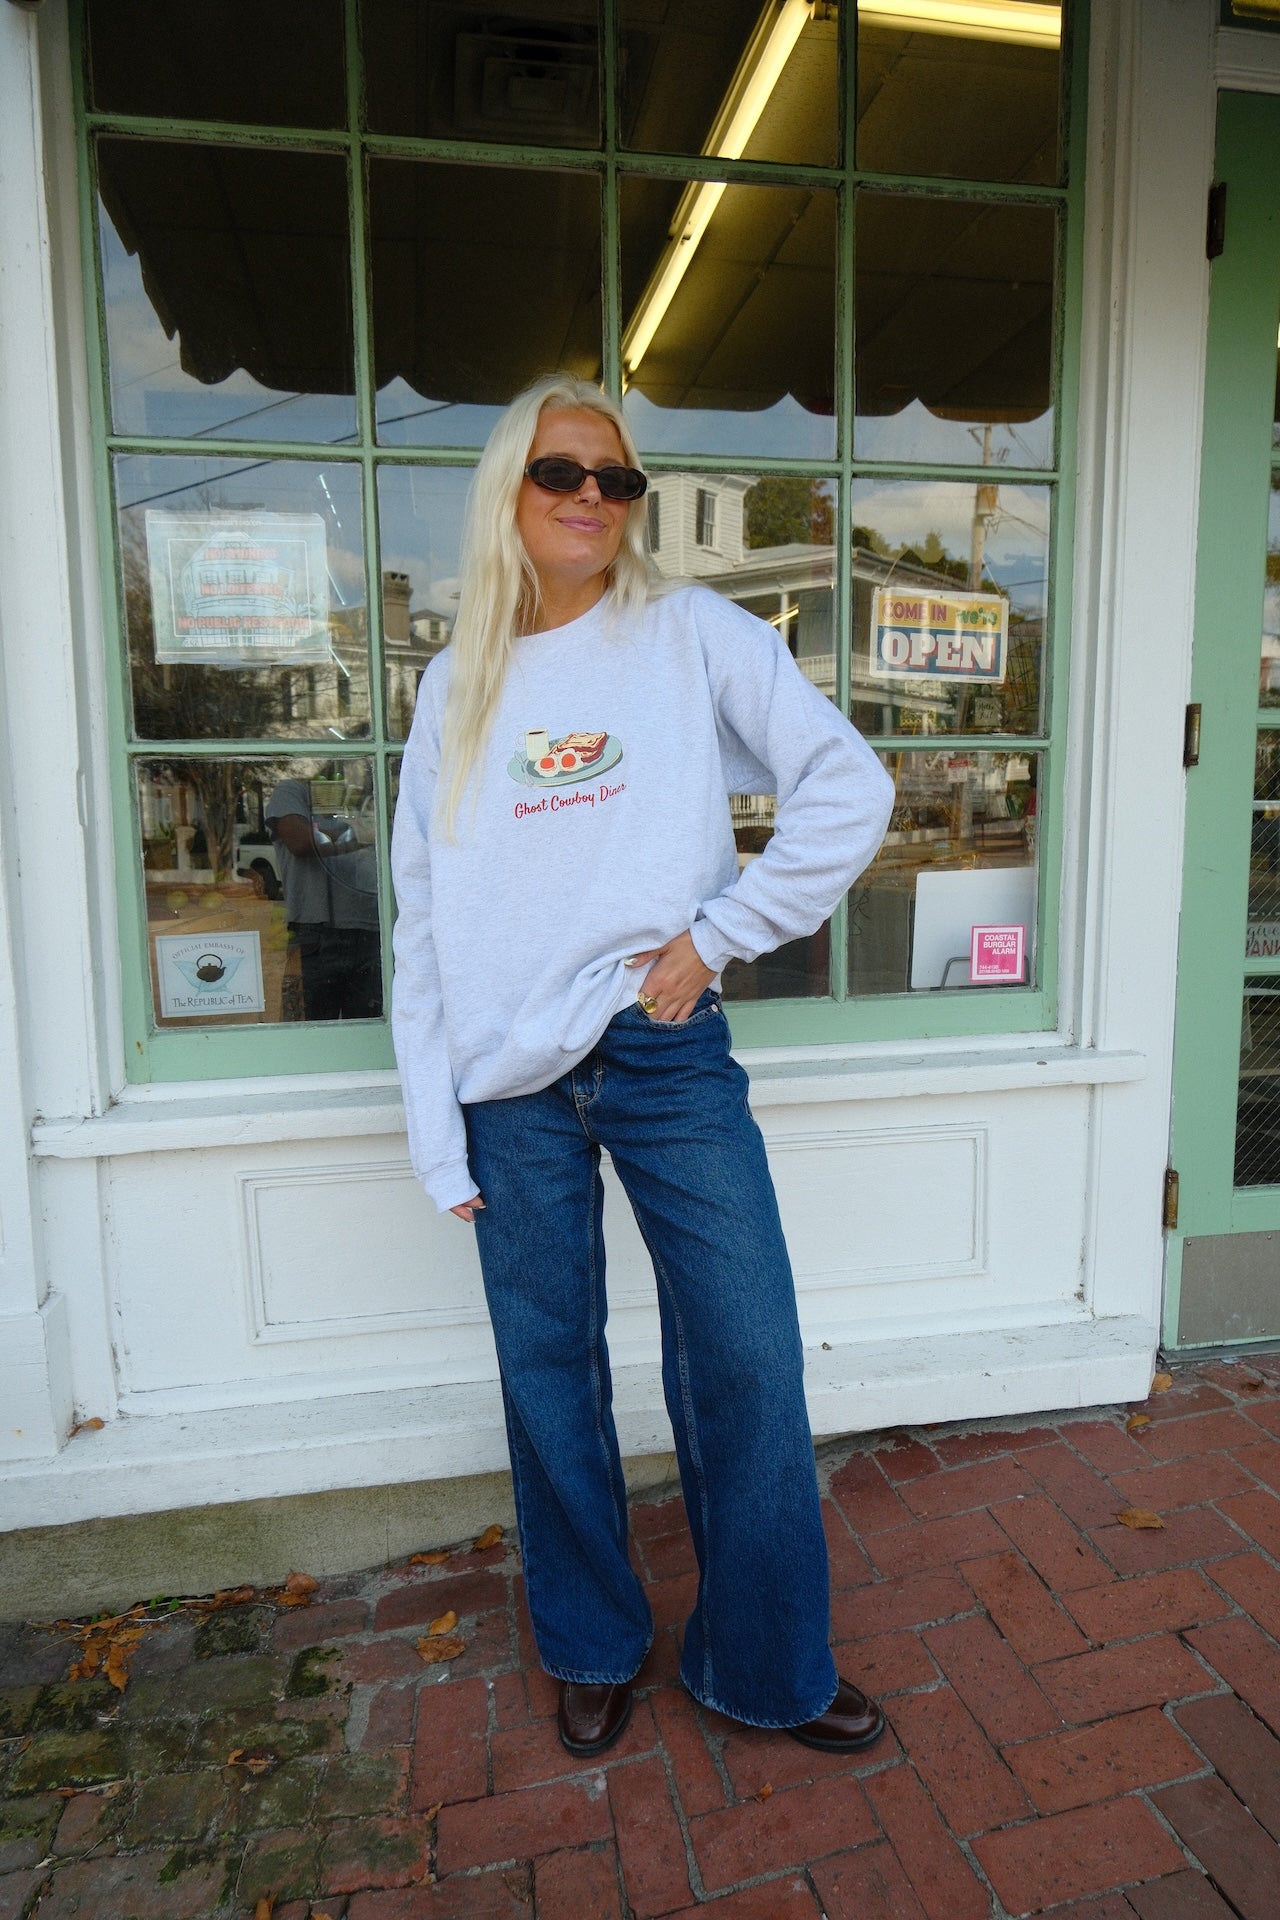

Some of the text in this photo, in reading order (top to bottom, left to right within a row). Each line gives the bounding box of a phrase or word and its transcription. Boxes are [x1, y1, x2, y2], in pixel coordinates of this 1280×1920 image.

[204, 547, 221, 560] NO
[201, 583, 217, 596] NO
[883, 601, 928, 620] COME
[931, 604, 947, 622] IN
[178, 617, 195, 629] NO
[197, 617, 240, 629] PUBLIC
[881, 630, 996, 673] OPEN
[514, 783, 627, 819] Ghost Cowboy Diner
[172, 942, 245, 959] OFFICIAL EMBASSY OF
[172, 993, 254, 1008] The REPUBLIC of TEA
